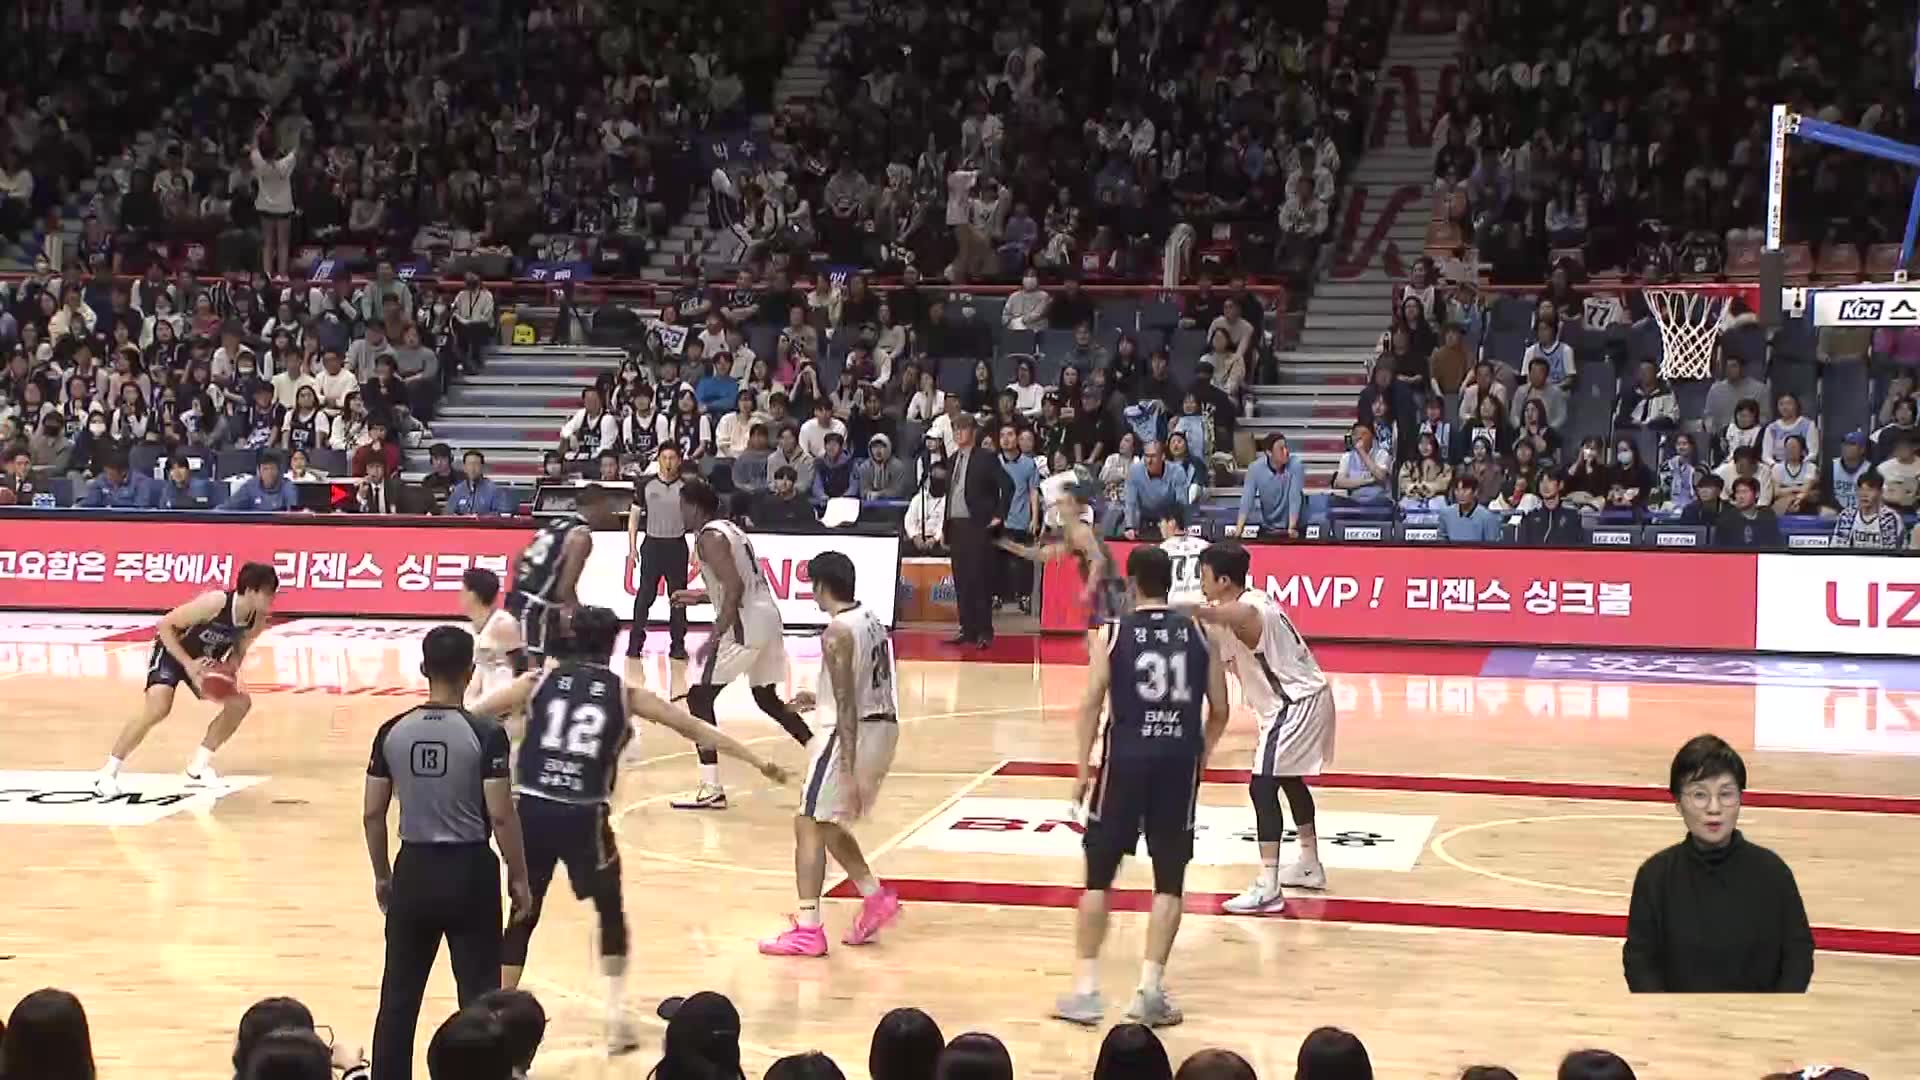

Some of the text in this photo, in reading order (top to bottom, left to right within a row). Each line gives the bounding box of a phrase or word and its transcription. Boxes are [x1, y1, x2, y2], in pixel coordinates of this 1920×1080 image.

[1840, 297, 1882, 320] KCC
[0, 551, 232, 584] 고요함은 주방에서
[272, 551, 383, 590] 리젠스
[1266, 575, 1360, 608] MVP
[1406, 577, 1511, 612] 리젠스
[1523, 579, 1632, 616] 싱크볼
[1135, 650, 1191, 702] 31
[540, 698, 606, 758] 12
[421, 748, 438, 769] 13
